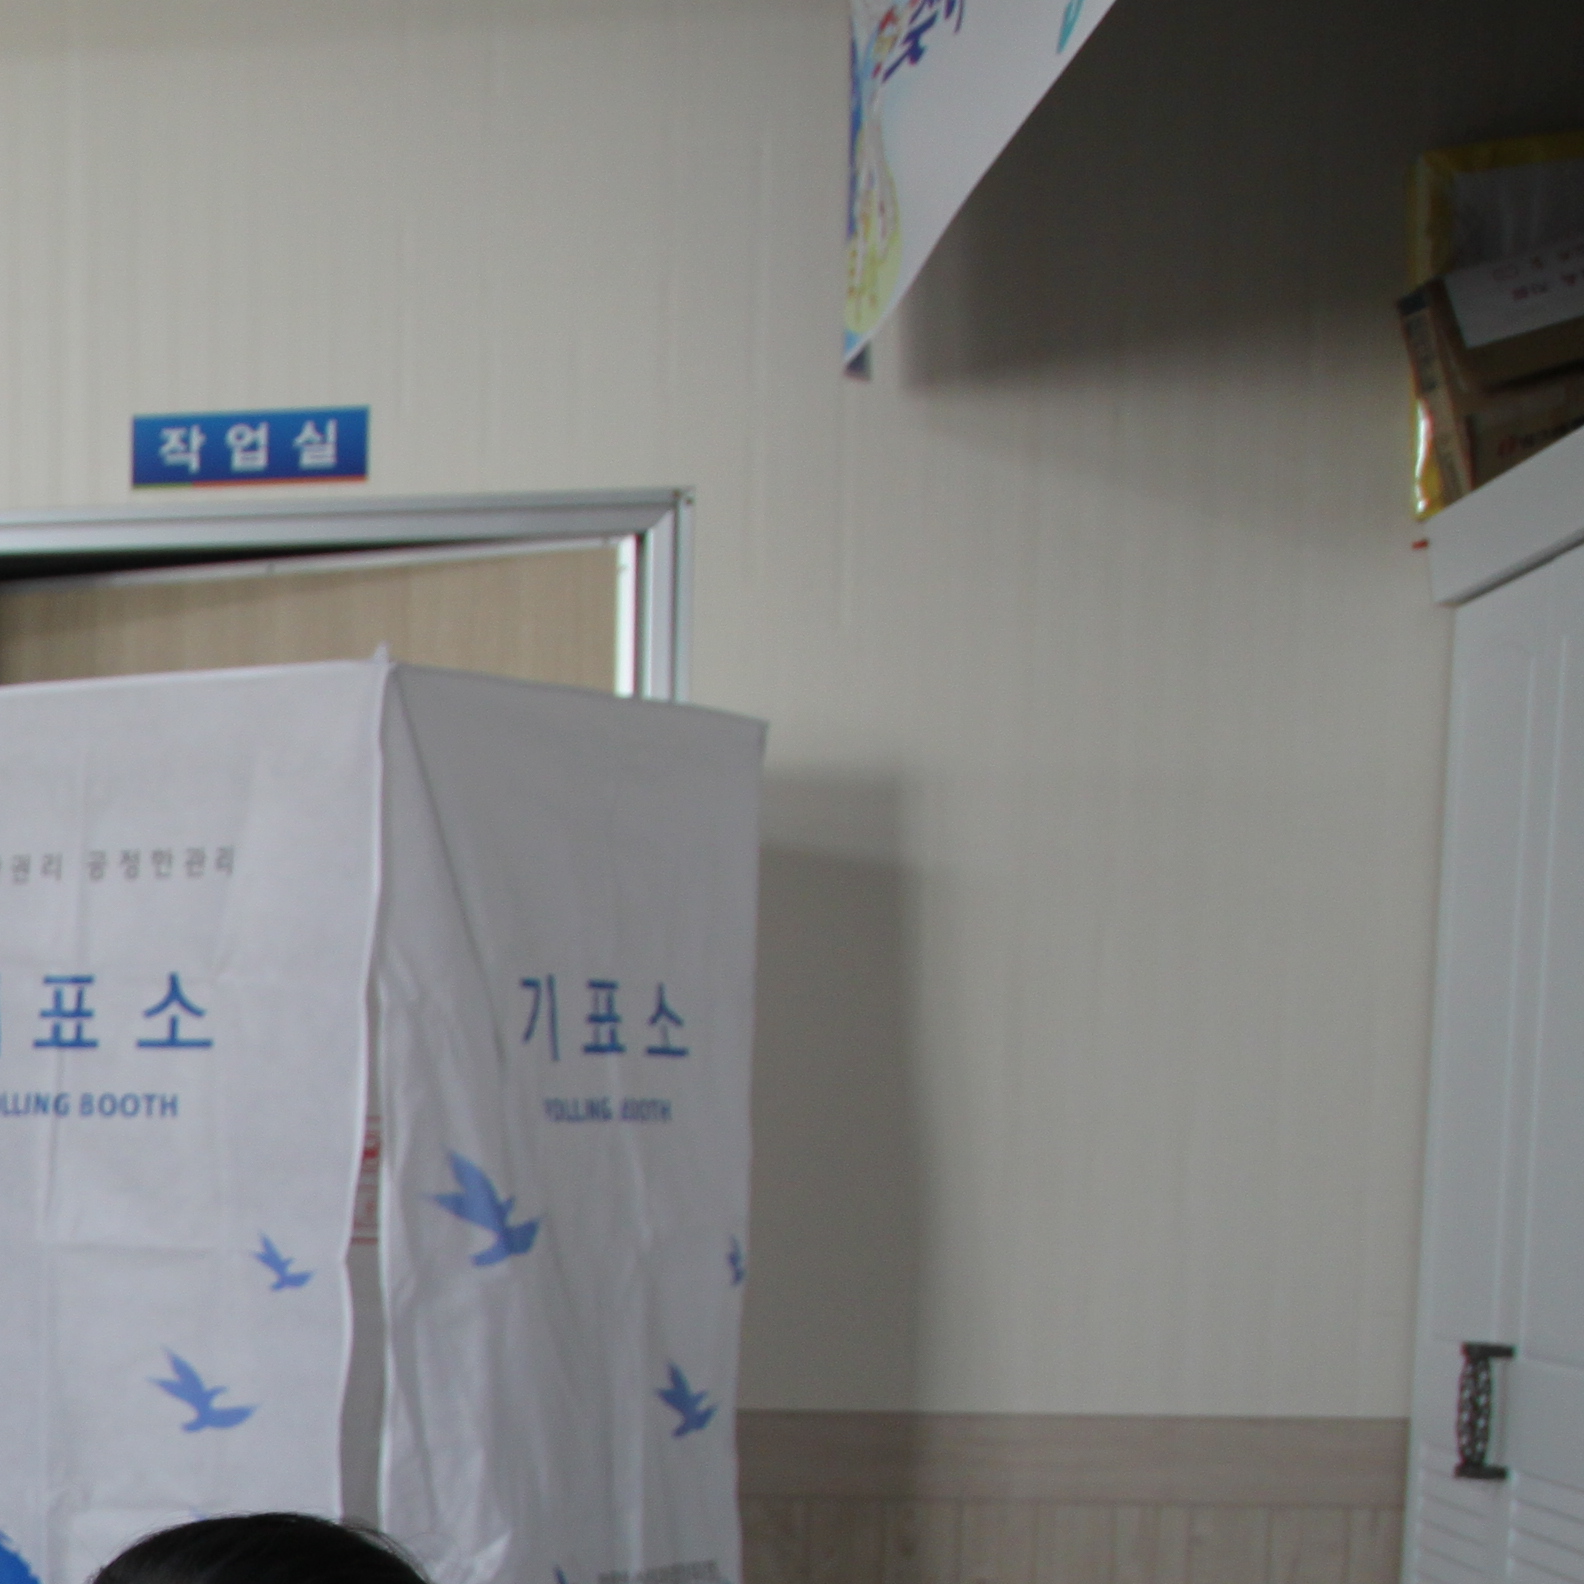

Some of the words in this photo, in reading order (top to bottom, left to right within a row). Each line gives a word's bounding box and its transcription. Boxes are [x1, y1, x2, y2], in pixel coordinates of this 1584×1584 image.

[159, 419, 338, 474] 작업실
[88, 845, 234, 882] 공정한관리
[521, 974, 689, 1062] 기표소
[79, 1094, 179, 1117] BOOTH
